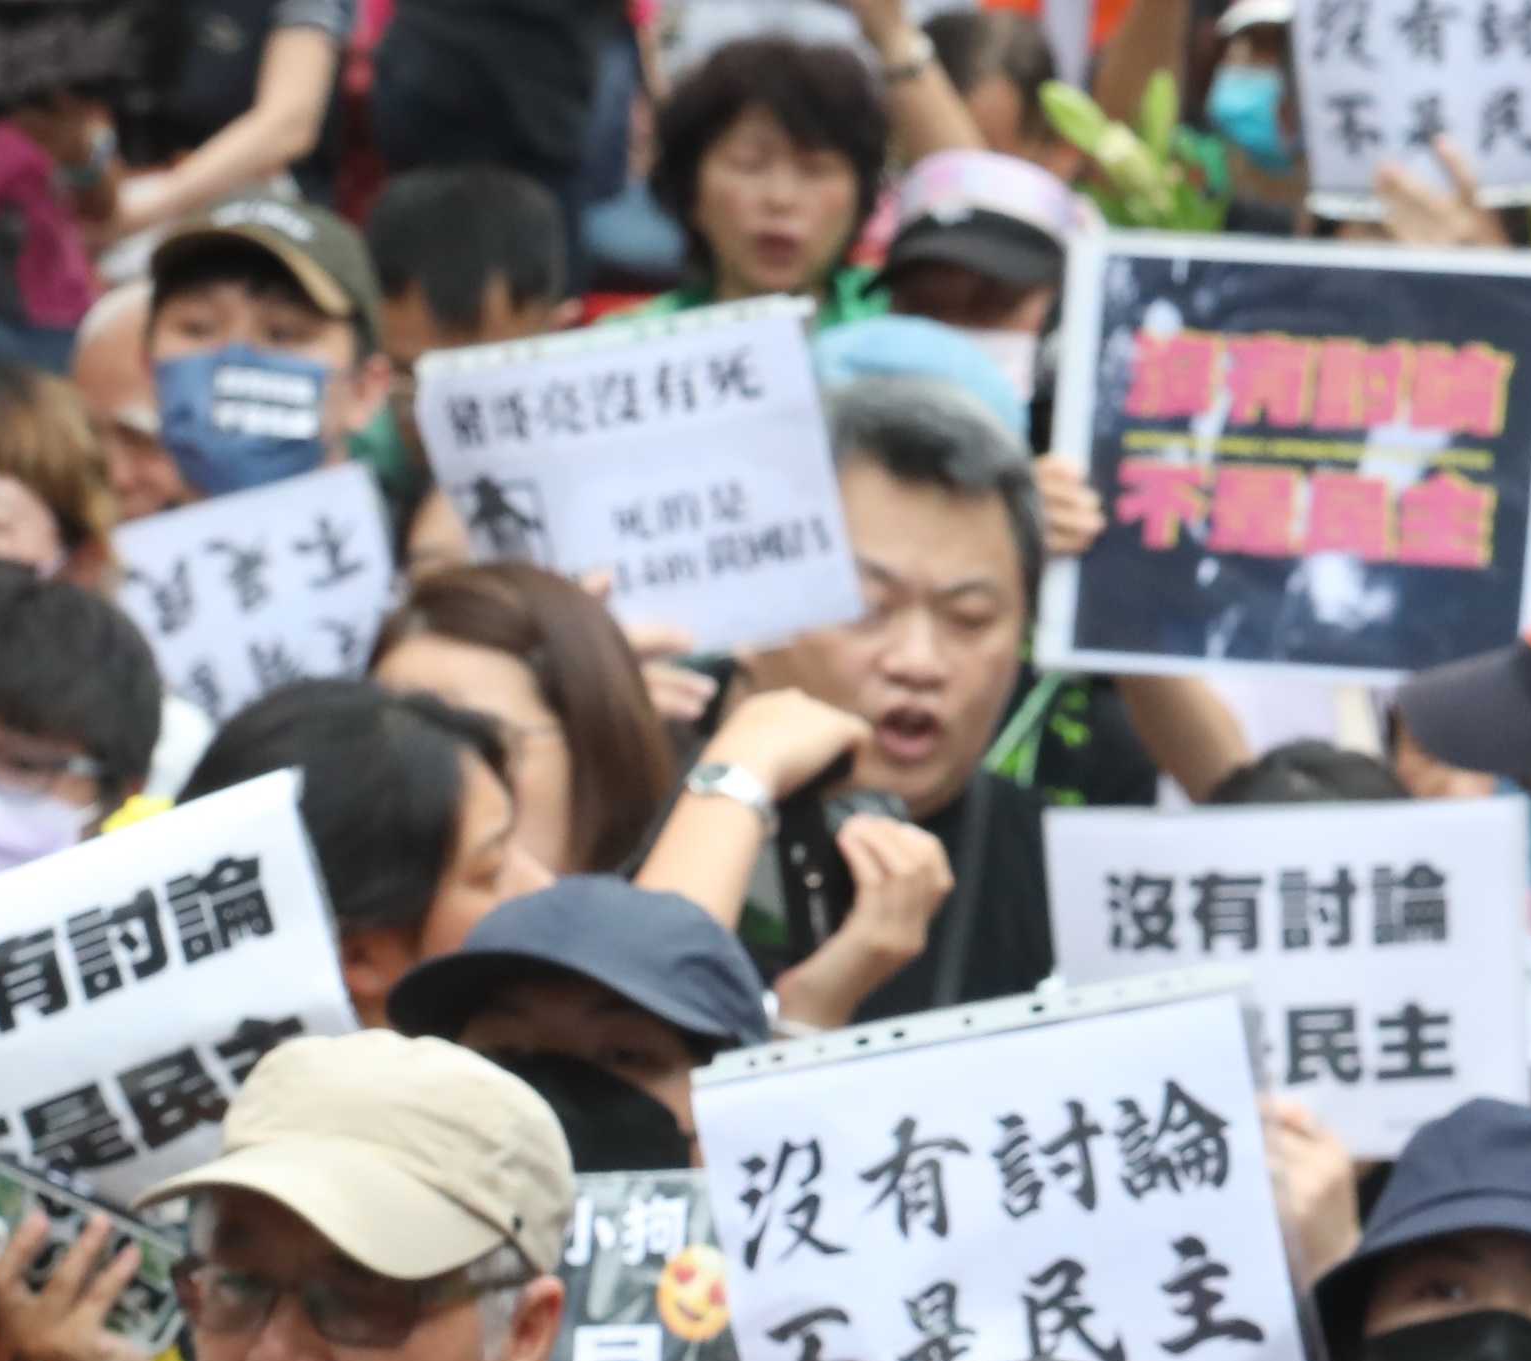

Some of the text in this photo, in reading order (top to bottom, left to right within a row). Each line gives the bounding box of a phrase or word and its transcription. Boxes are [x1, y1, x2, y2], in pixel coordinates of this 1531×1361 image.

[1124, 328, 1516, 438] 沒有討論
[1115, 456, 1498, 570] 不是民主
[1105, 862, 1450, 953] 沒有討論
[1267, 1003, 1455, 1087] 民主
[739, 1078, 1232, 1271] 沒有討論
